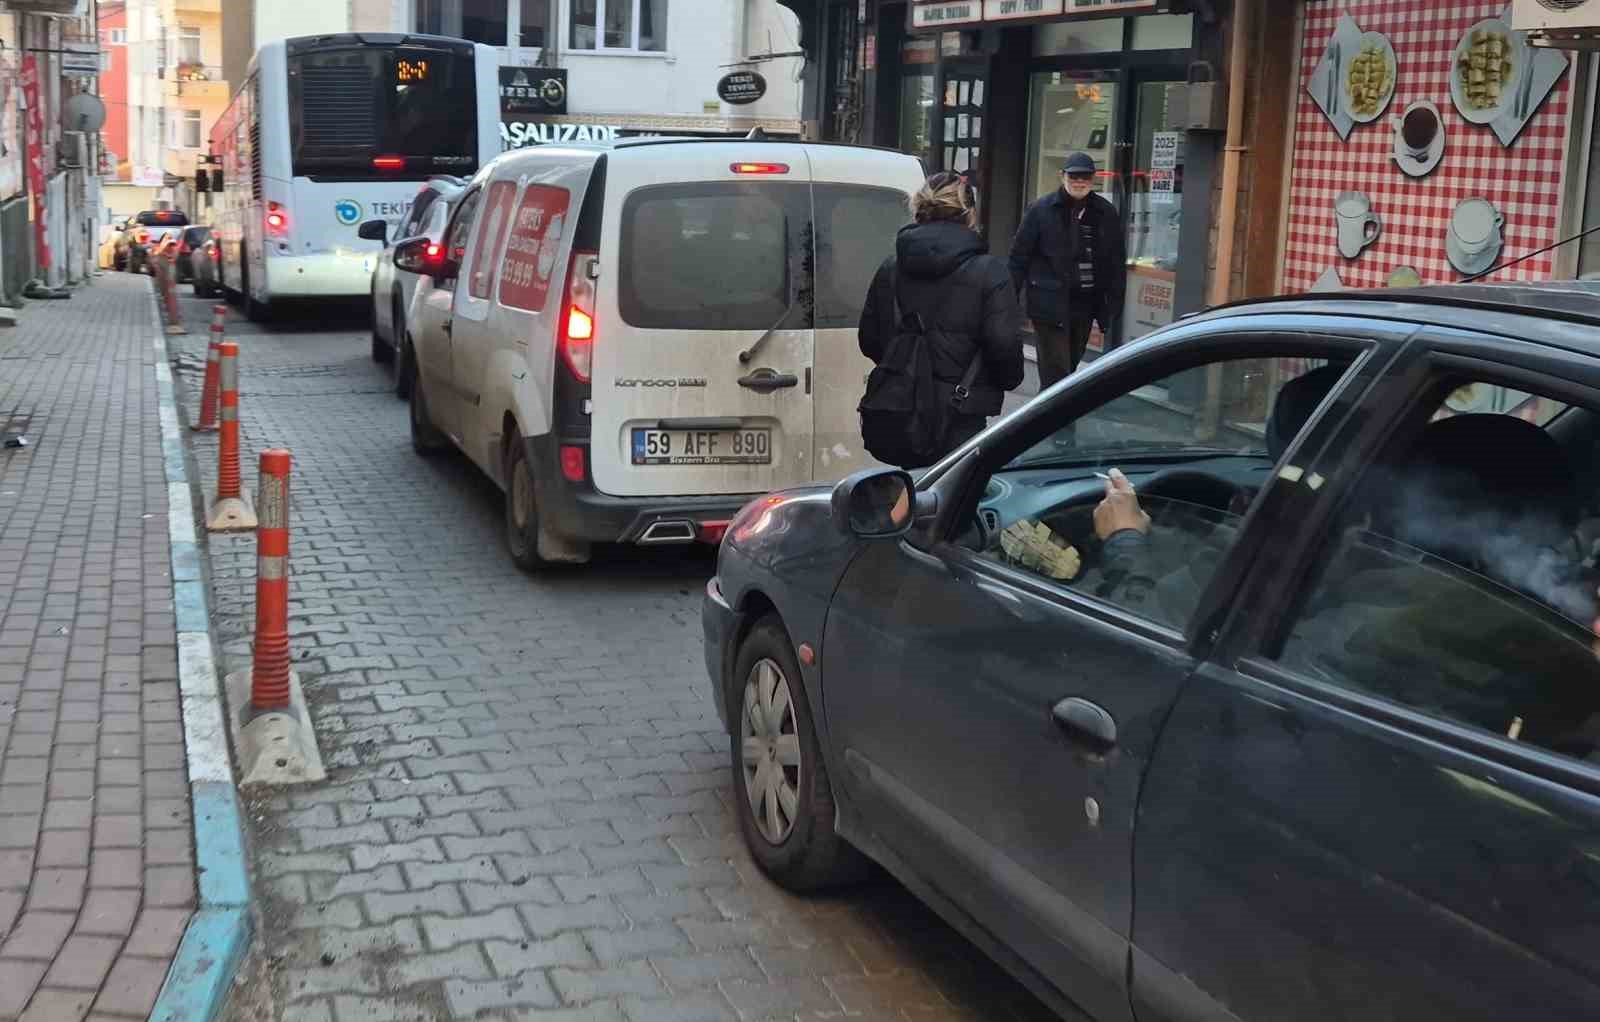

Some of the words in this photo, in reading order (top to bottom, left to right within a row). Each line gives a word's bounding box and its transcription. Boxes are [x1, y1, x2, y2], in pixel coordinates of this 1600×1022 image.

[1154, 136, 1176, 149] 2025
[647, 432, 671, 455] 59
[684, 432, 719, 455] AFF
[732, 432, 767, 455] 890
